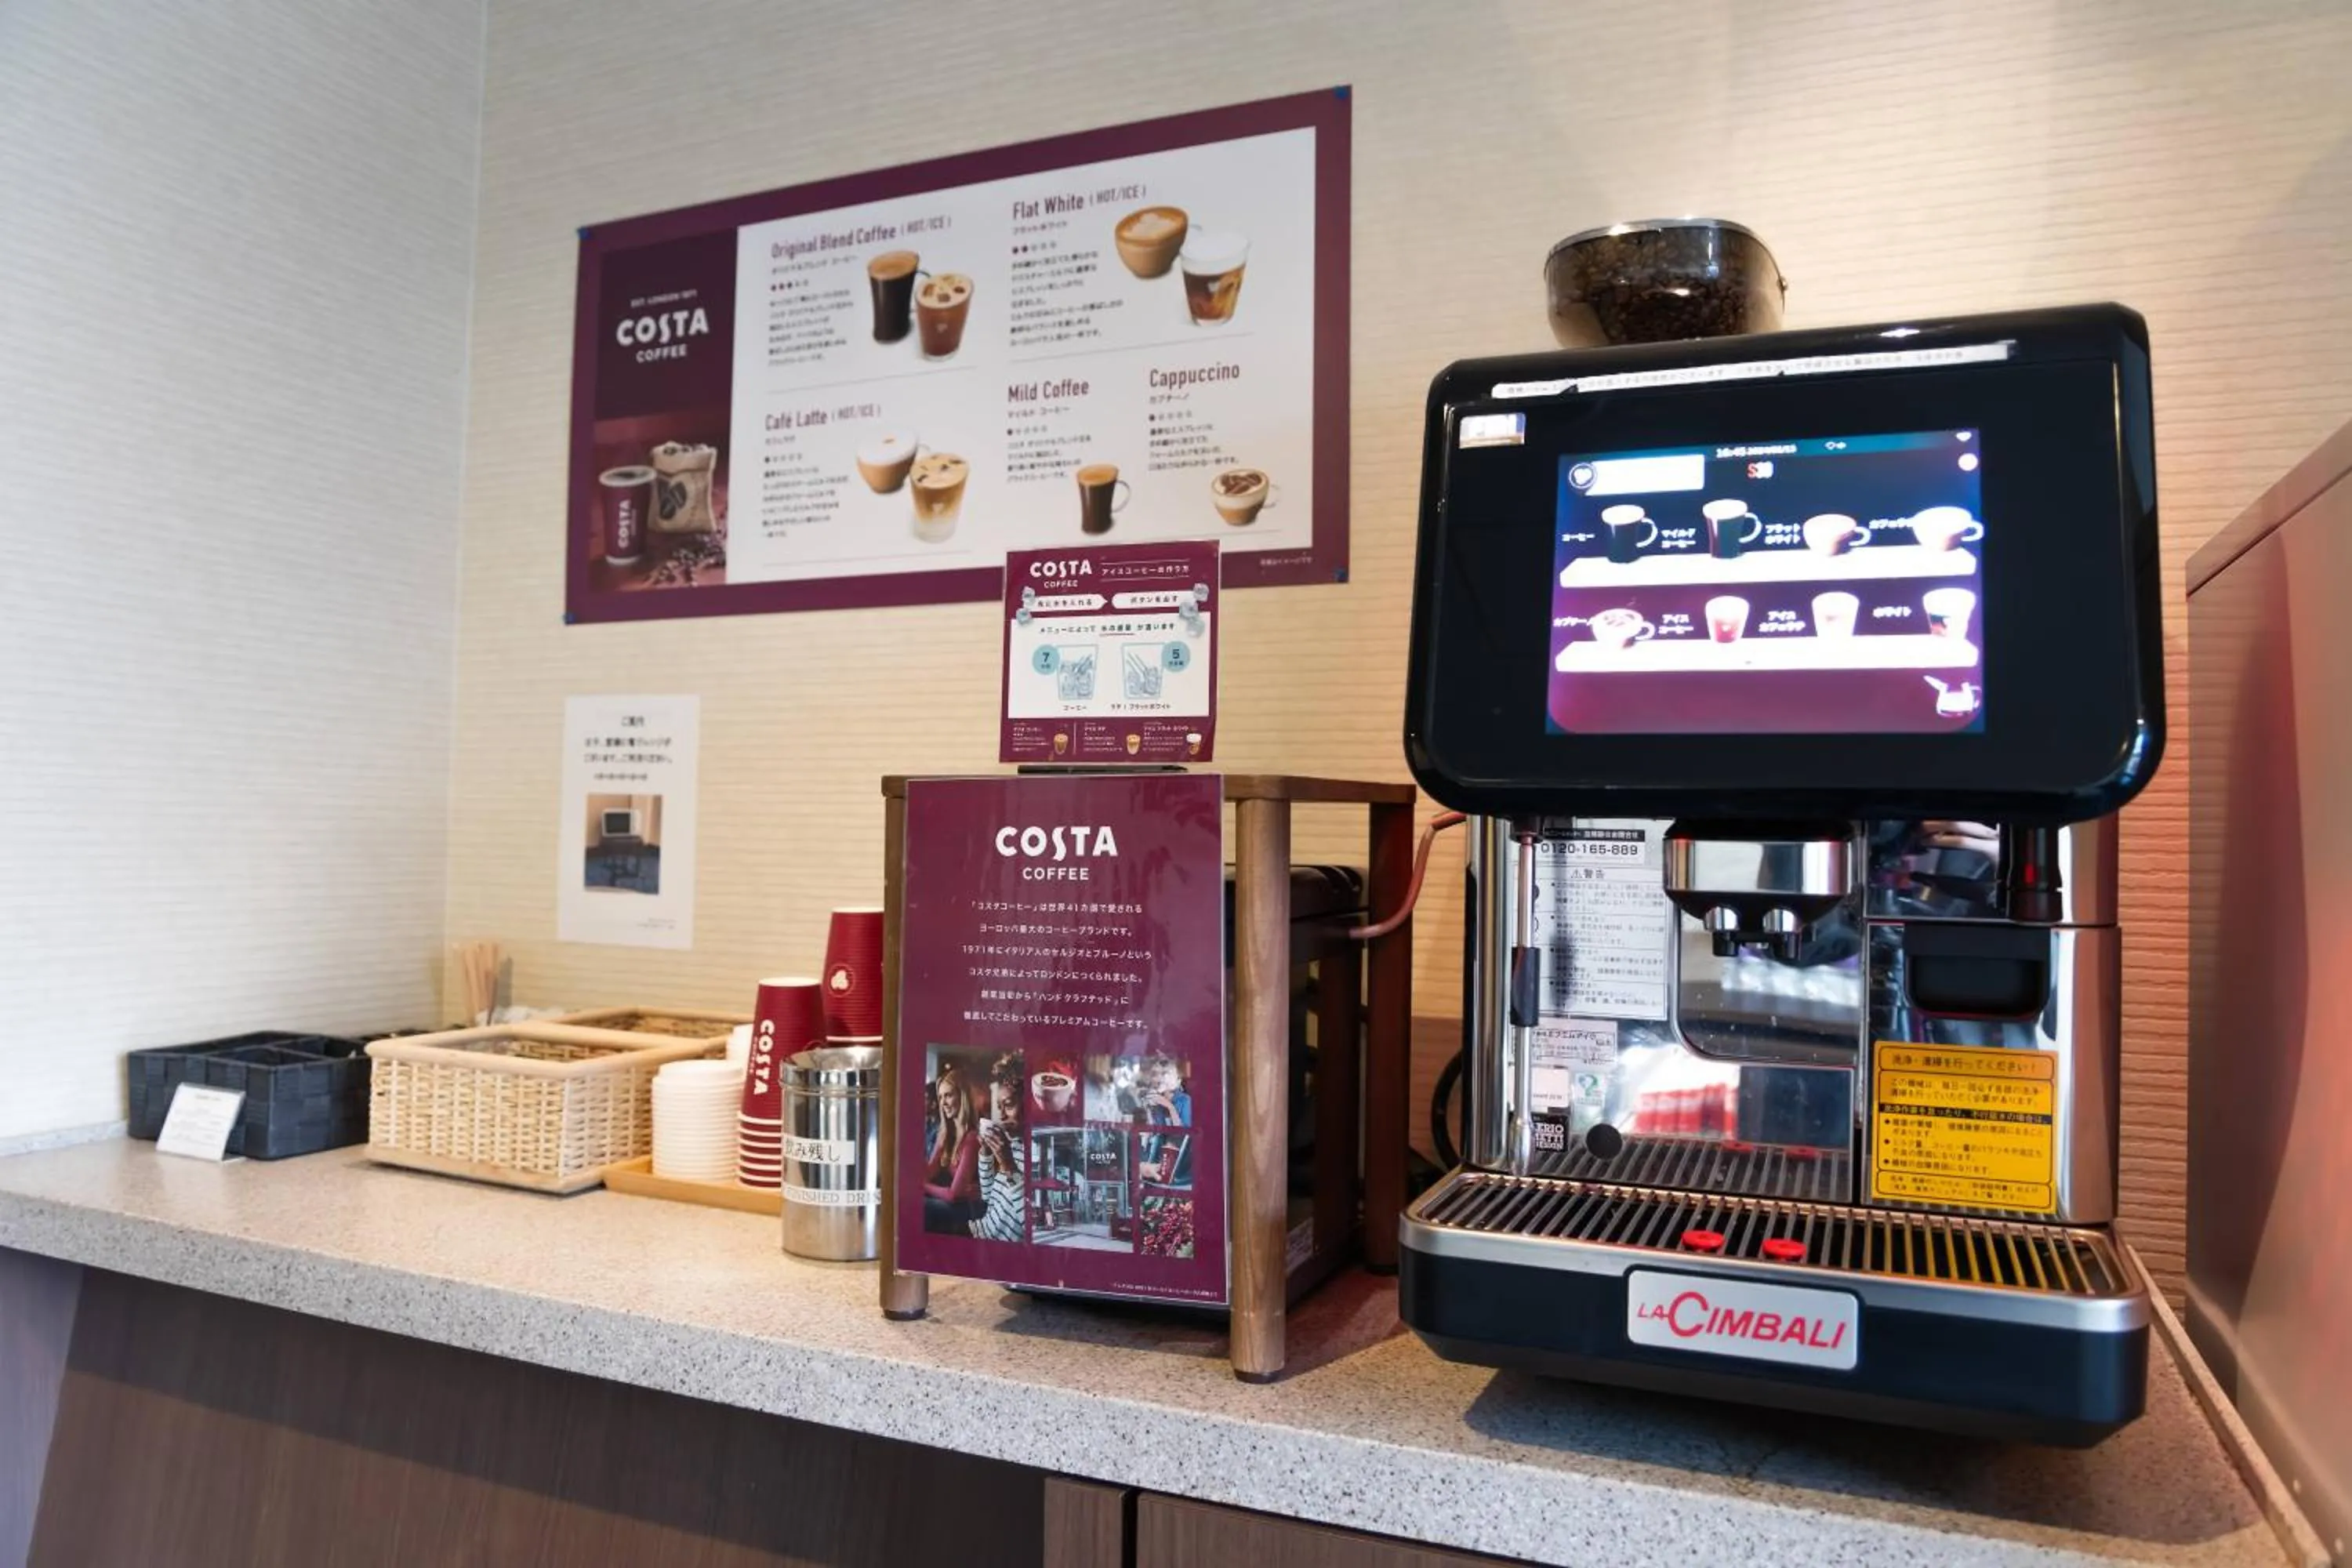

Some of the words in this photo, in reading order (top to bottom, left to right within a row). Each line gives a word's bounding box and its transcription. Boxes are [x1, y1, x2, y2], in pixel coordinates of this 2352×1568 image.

[1012, 201, 1040, 220] Flat
[1044, 194, 1084, 214] White
[771, 238, 818, 260] Original
[819, 231, 854, 250] Blend
[856, 225, 897, 245] Coffee
[615, 307, 710, 347] COSTA
[636, 343, 688, 364] COFFEE
[1149, 362, 1240, 390] Cappuccino
[1007, 383, 1037, 402] Mild
[1043, 378, 1090, 399] Coffee
[797, 409, 827, 427] Latte
[1029, 559, 1093, 578] COSTA
[1044, 579, 1078, 589] COFFEE
[1042, 652, 1051, 663] 7
[1172, 648, 1180, 659] 5
[995, 826, 1118, 862] COSTA
[1022, 867, 1090, 880] COFFEE
[753, 1019, 775, 1095] COSTA
[1637, 1302, 1665, 1321] LA
[1667, 1290, 1846, 1349] CIMBALI
